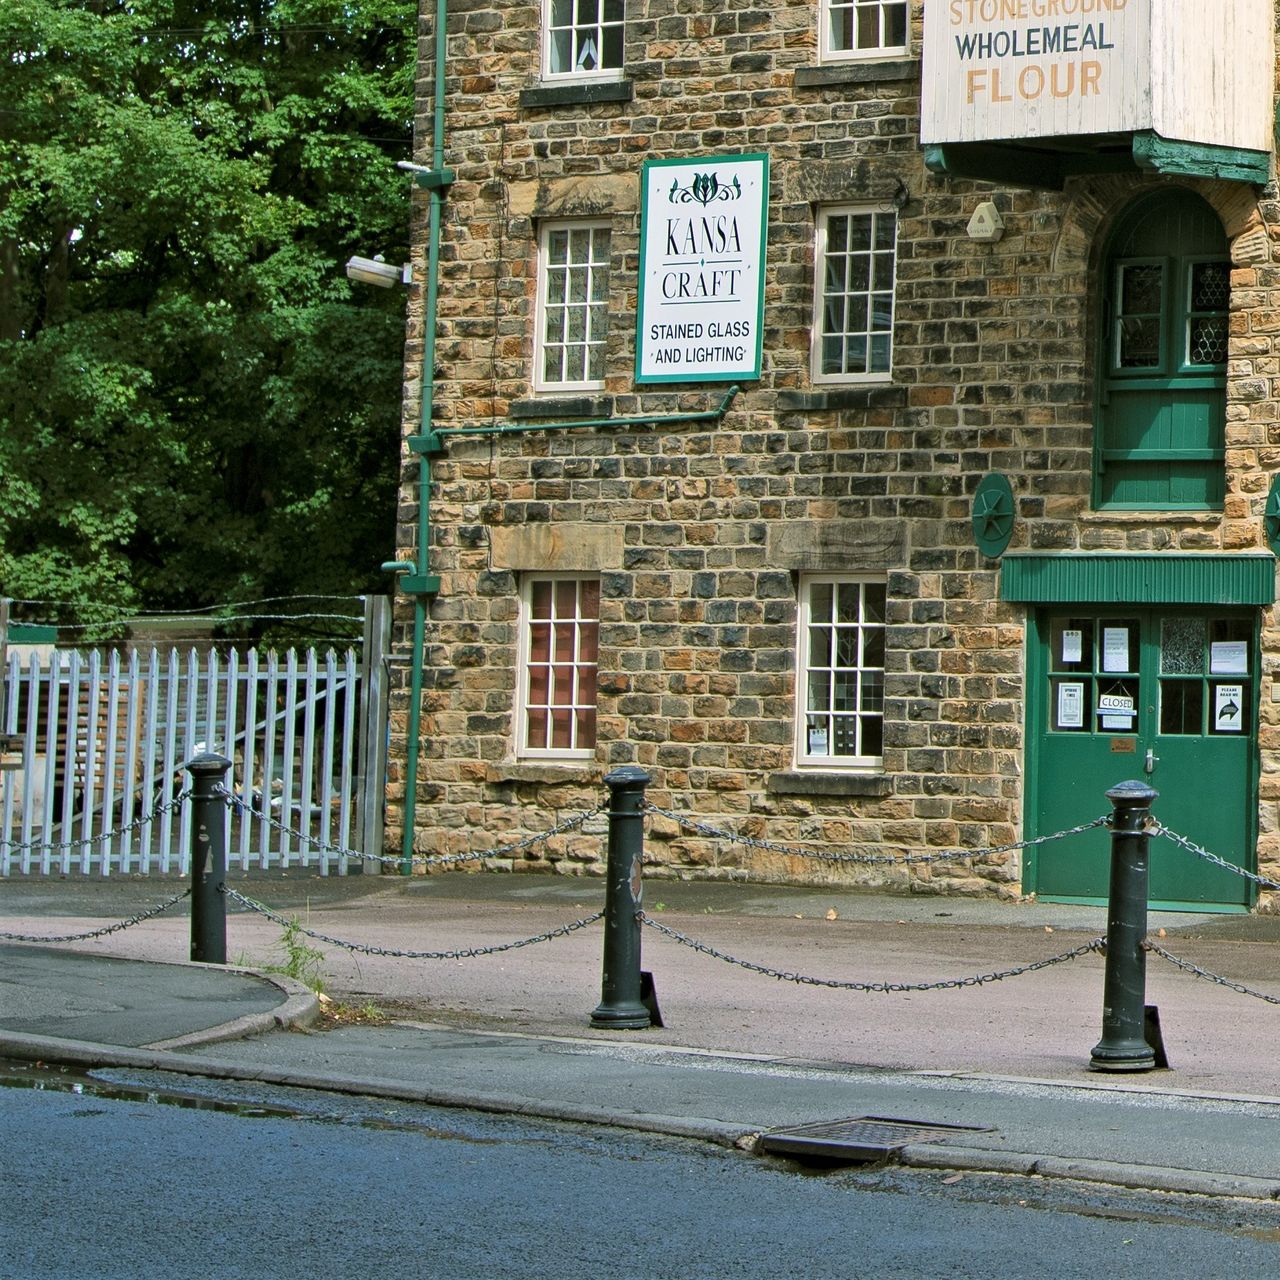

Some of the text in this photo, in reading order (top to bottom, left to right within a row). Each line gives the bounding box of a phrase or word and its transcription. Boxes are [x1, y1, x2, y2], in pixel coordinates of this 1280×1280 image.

[955, 22, 1115, 61] WHOLEMEAL
[967, 60, 1102, 105] FLOUR
[665, 215, 742, 256] KANSA
[662, 269, 742, 299] CRAFT
[650, 321, 750, 340] STAINED GLASS
[655, 346, 744, 364] AND LIGHTING
[1102, 697, 1133, 709] CLOSED
